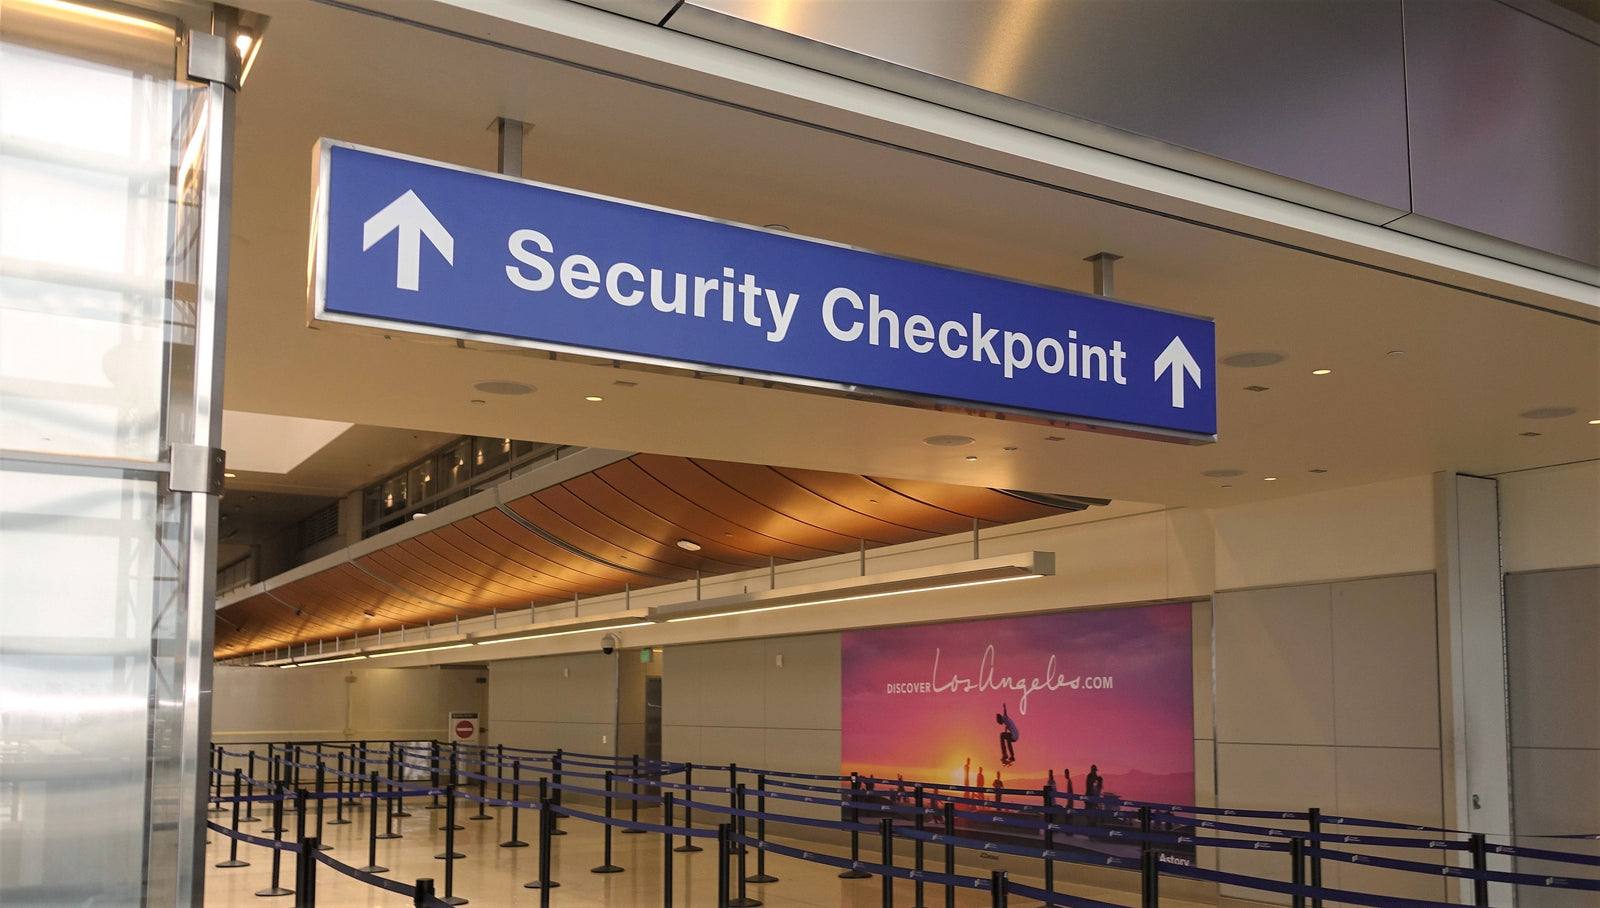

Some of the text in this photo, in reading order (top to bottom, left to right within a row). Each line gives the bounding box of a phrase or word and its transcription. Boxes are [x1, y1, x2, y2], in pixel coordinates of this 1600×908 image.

[505, 228, 1128, 386] Security Checkpoint
[886, 682, 931, 694] DISCOVER
